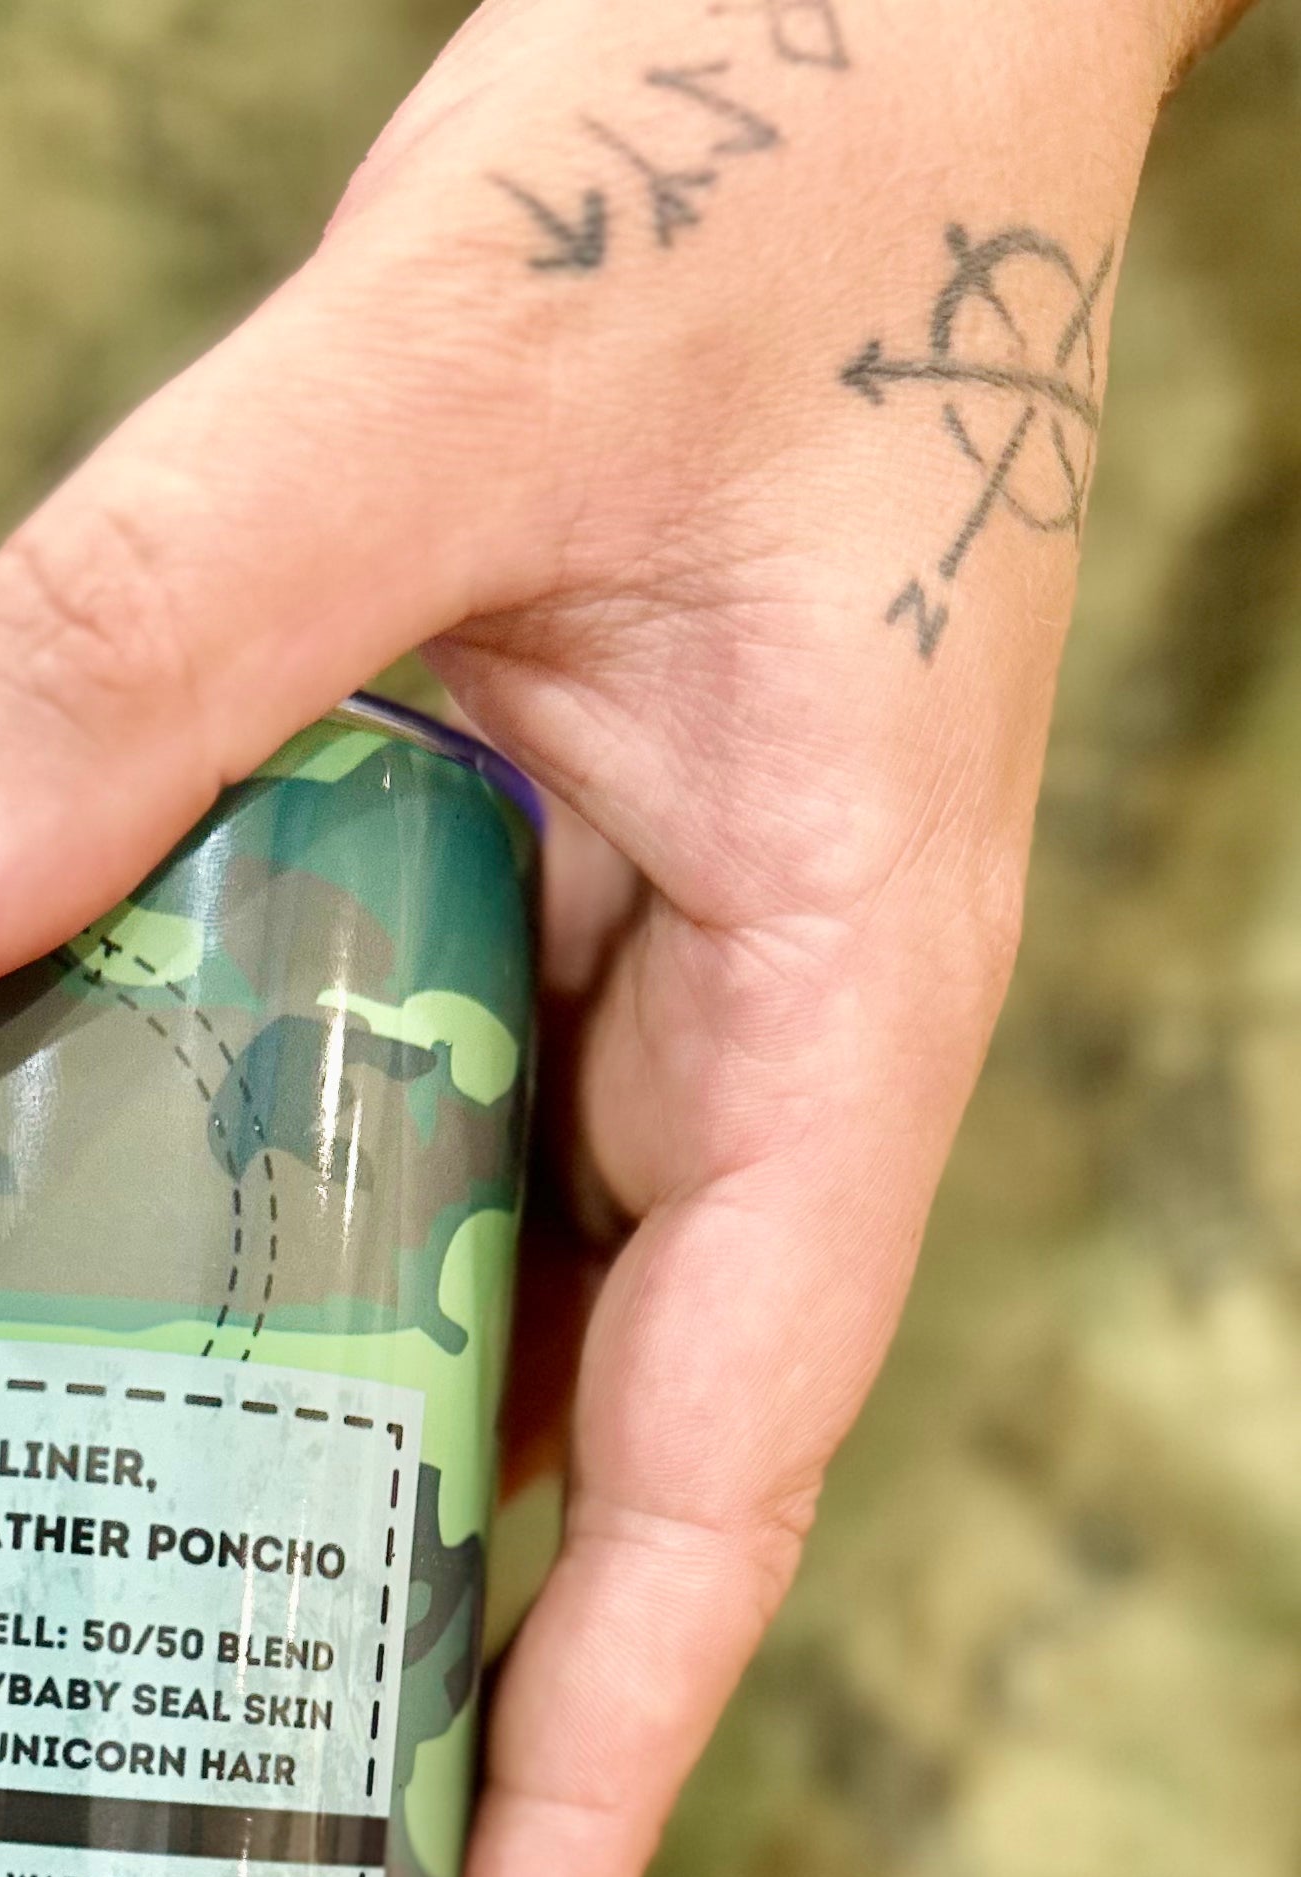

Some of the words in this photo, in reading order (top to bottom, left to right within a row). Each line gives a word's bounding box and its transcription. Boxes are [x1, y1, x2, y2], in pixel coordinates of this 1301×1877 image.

[148, 1526, 345, 1579] PONCHO
[83, 1621, 203, 1660] 50/50
[218, 1633, 334, 1671] BLEND
[132, 1685, 230, 1723] SEAL
[244, 1695, 333, 1730] SKIN
[201, 1749, 296, 1786] HAIR
